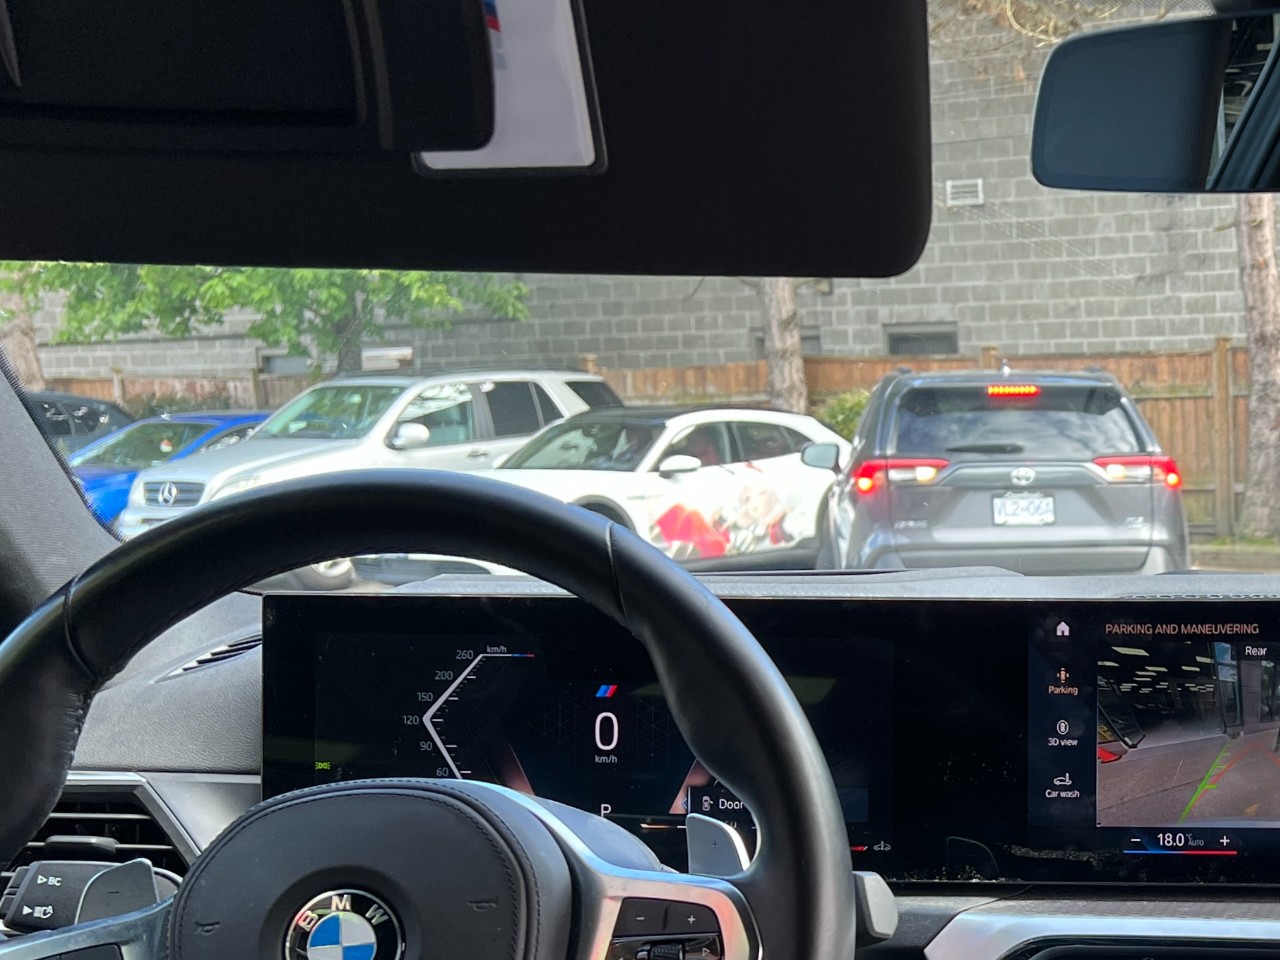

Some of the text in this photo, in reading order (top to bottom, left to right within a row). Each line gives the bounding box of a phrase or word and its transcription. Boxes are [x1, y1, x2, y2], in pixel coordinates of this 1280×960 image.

[1105, 623, 1260, 635] PARKING AND MANEUVERING
[486, 645, 508, 654] km/h
[1245, 645, 1268, 656] Rear
[455, 650, 474, 660] 260
[434, 671, 454, 680] 200
[1048, 685, 1079, 696] Parking
[416, 692, 434, 702] 150
[402, 715, 420, 725] 120
[594, 711, 619, 751] 0
[420, 741, 433, 751] 90
[1047, 737, 1078, 747] 3D view
[594, 754, 618, 764] km/h
[436, 767, 449, 777] 60
[1045, 789, 1080, 799] Car wash
[719, 798, 744, 810] Door
[600, 803, 612, 818] P
[1157, 832, 1185, 847] 18.0
[1188, 839, 1205, 847] AUTO
[47, 876, 62, 886] BC
[298, 894, 389, 931] BMW
